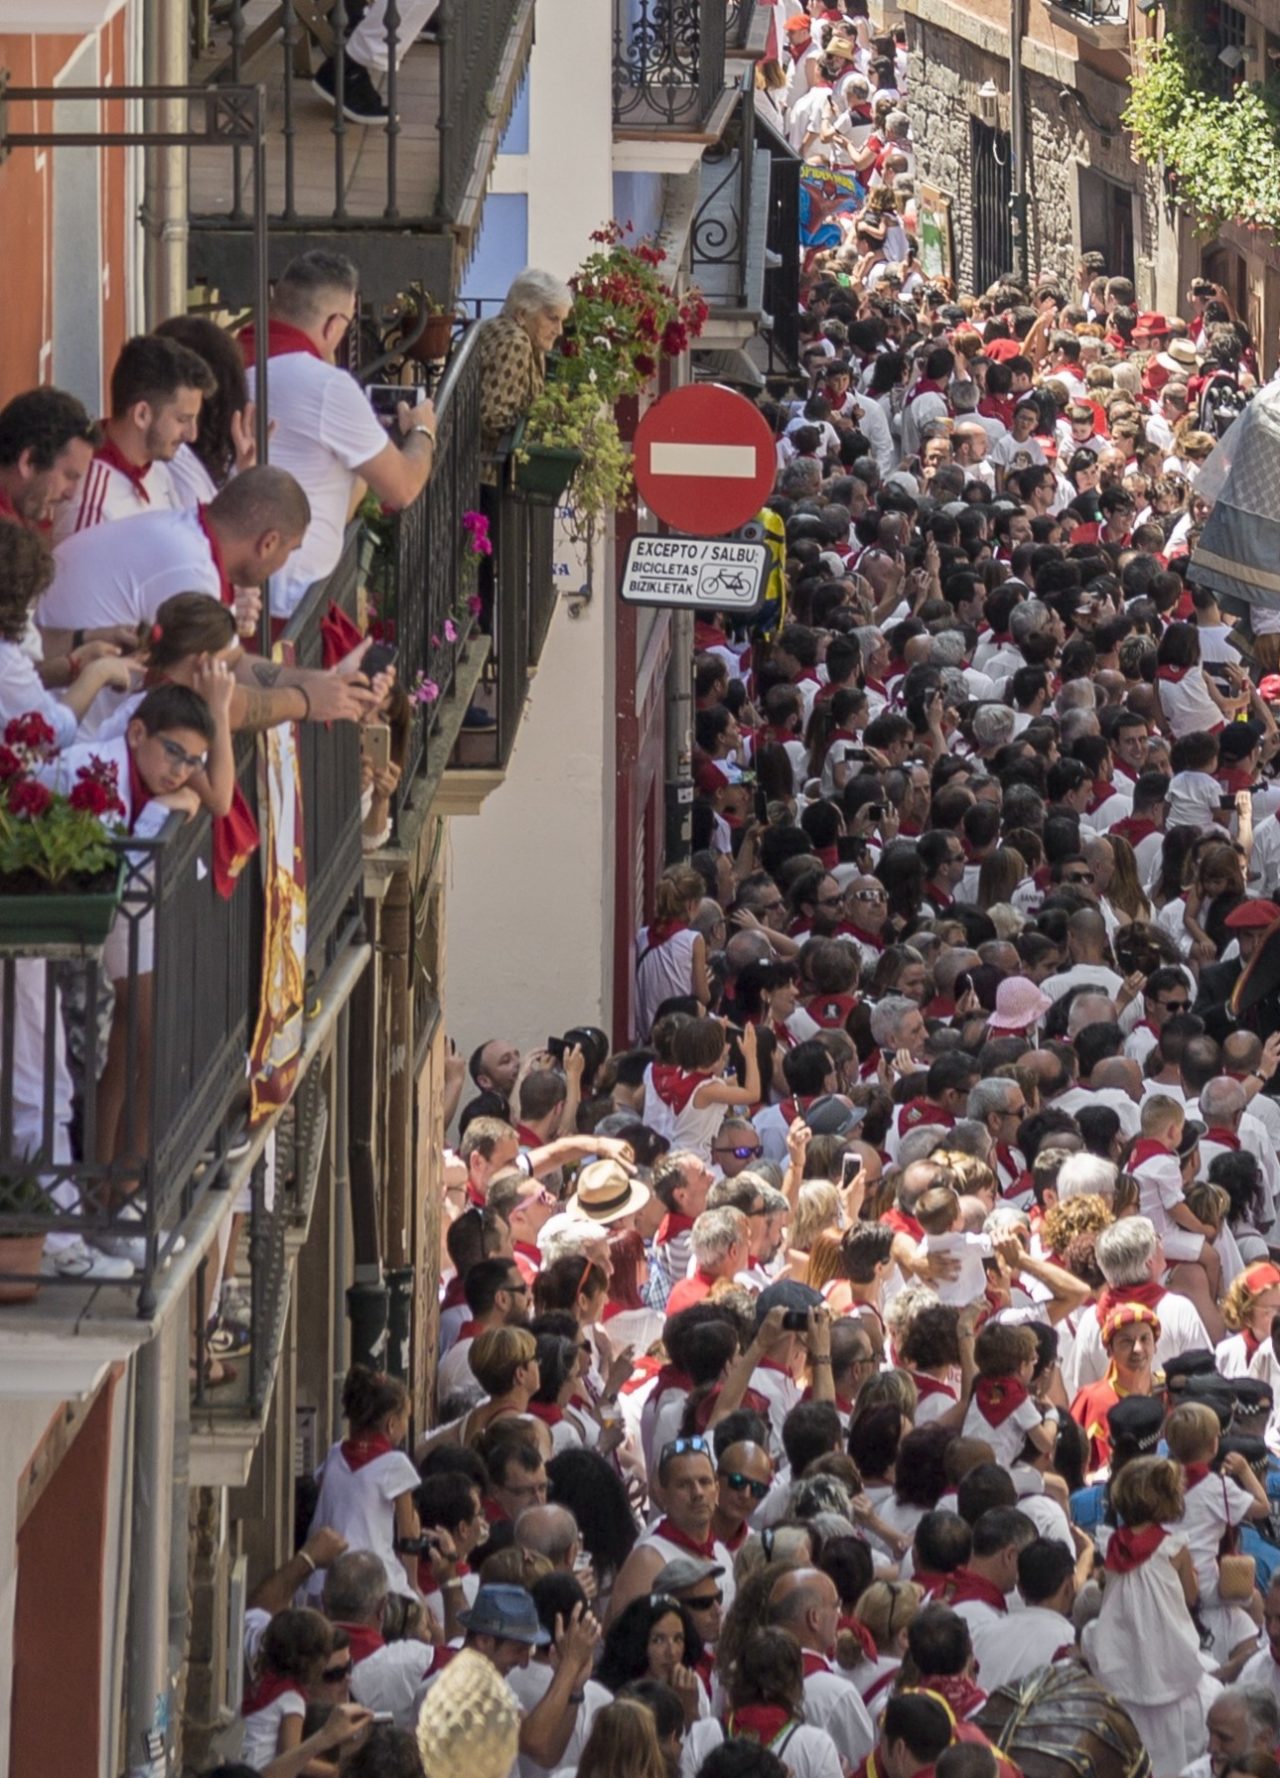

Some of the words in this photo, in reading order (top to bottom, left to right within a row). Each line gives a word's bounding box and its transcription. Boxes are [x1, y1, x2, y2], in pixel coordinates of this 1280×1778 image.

[637, 542, 697, 558] EXCEPTO
[700, 545, 708, 559] /
[631, 561, 698, 576] BICICLETAS
[629, 581, 693, 595] BIZIKLETAK
